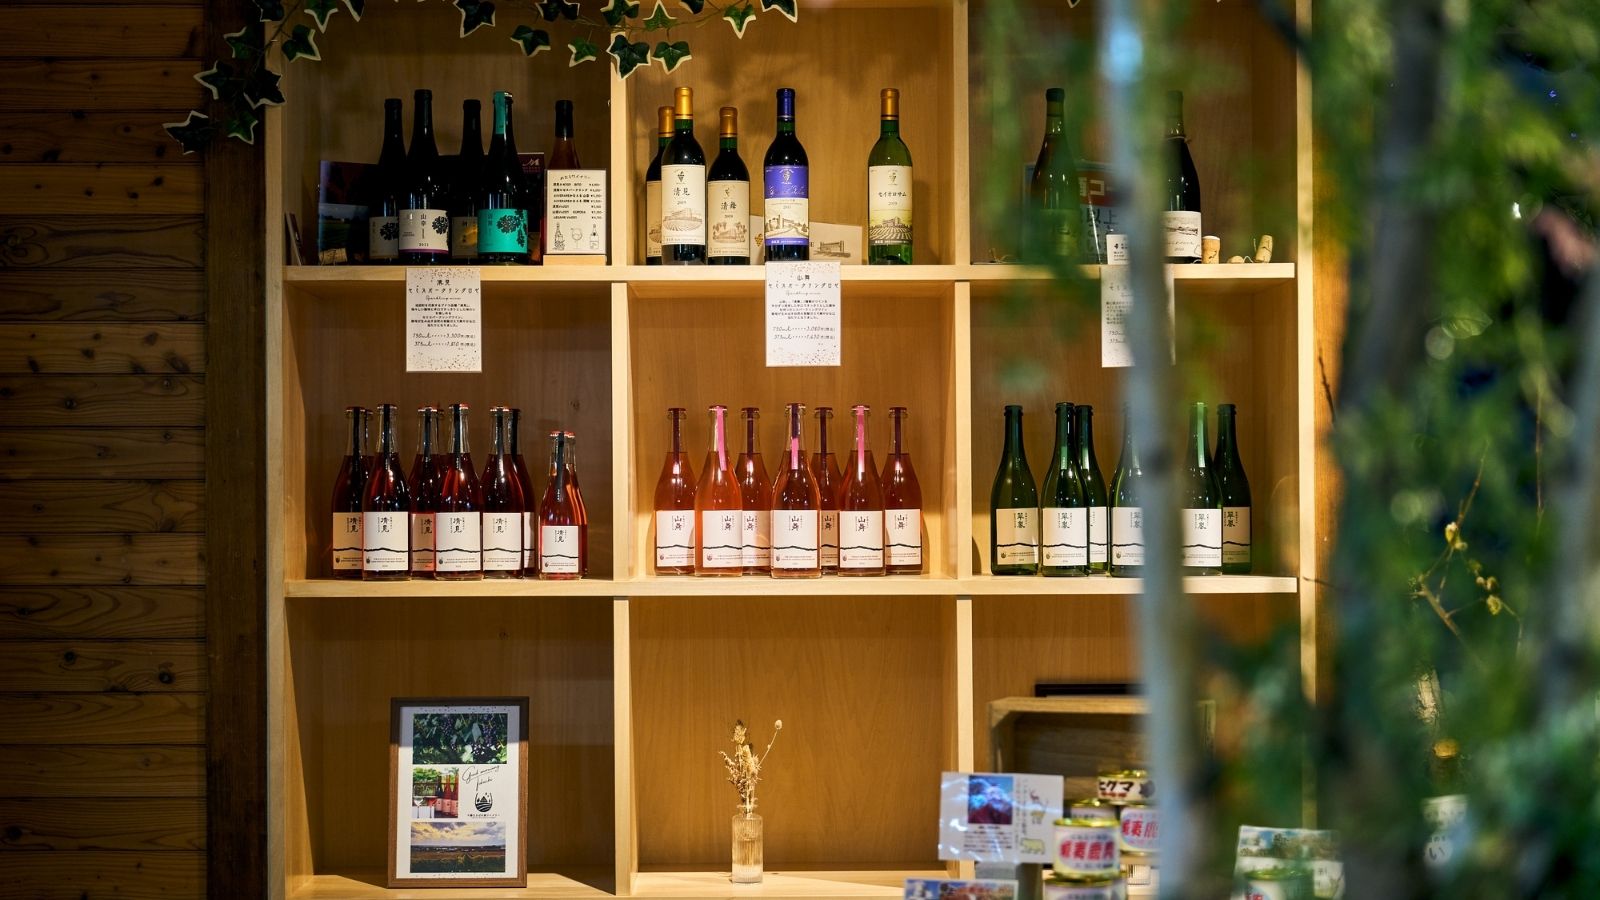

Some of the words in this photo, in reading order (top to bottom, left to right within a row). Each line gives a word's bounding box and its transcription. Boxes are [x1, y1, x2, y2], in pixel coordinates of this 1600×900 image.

[380, 516, 390, 533] 清見
[453, 517, 462, 534] 清見
[495, 517, 504, 534] 清見
